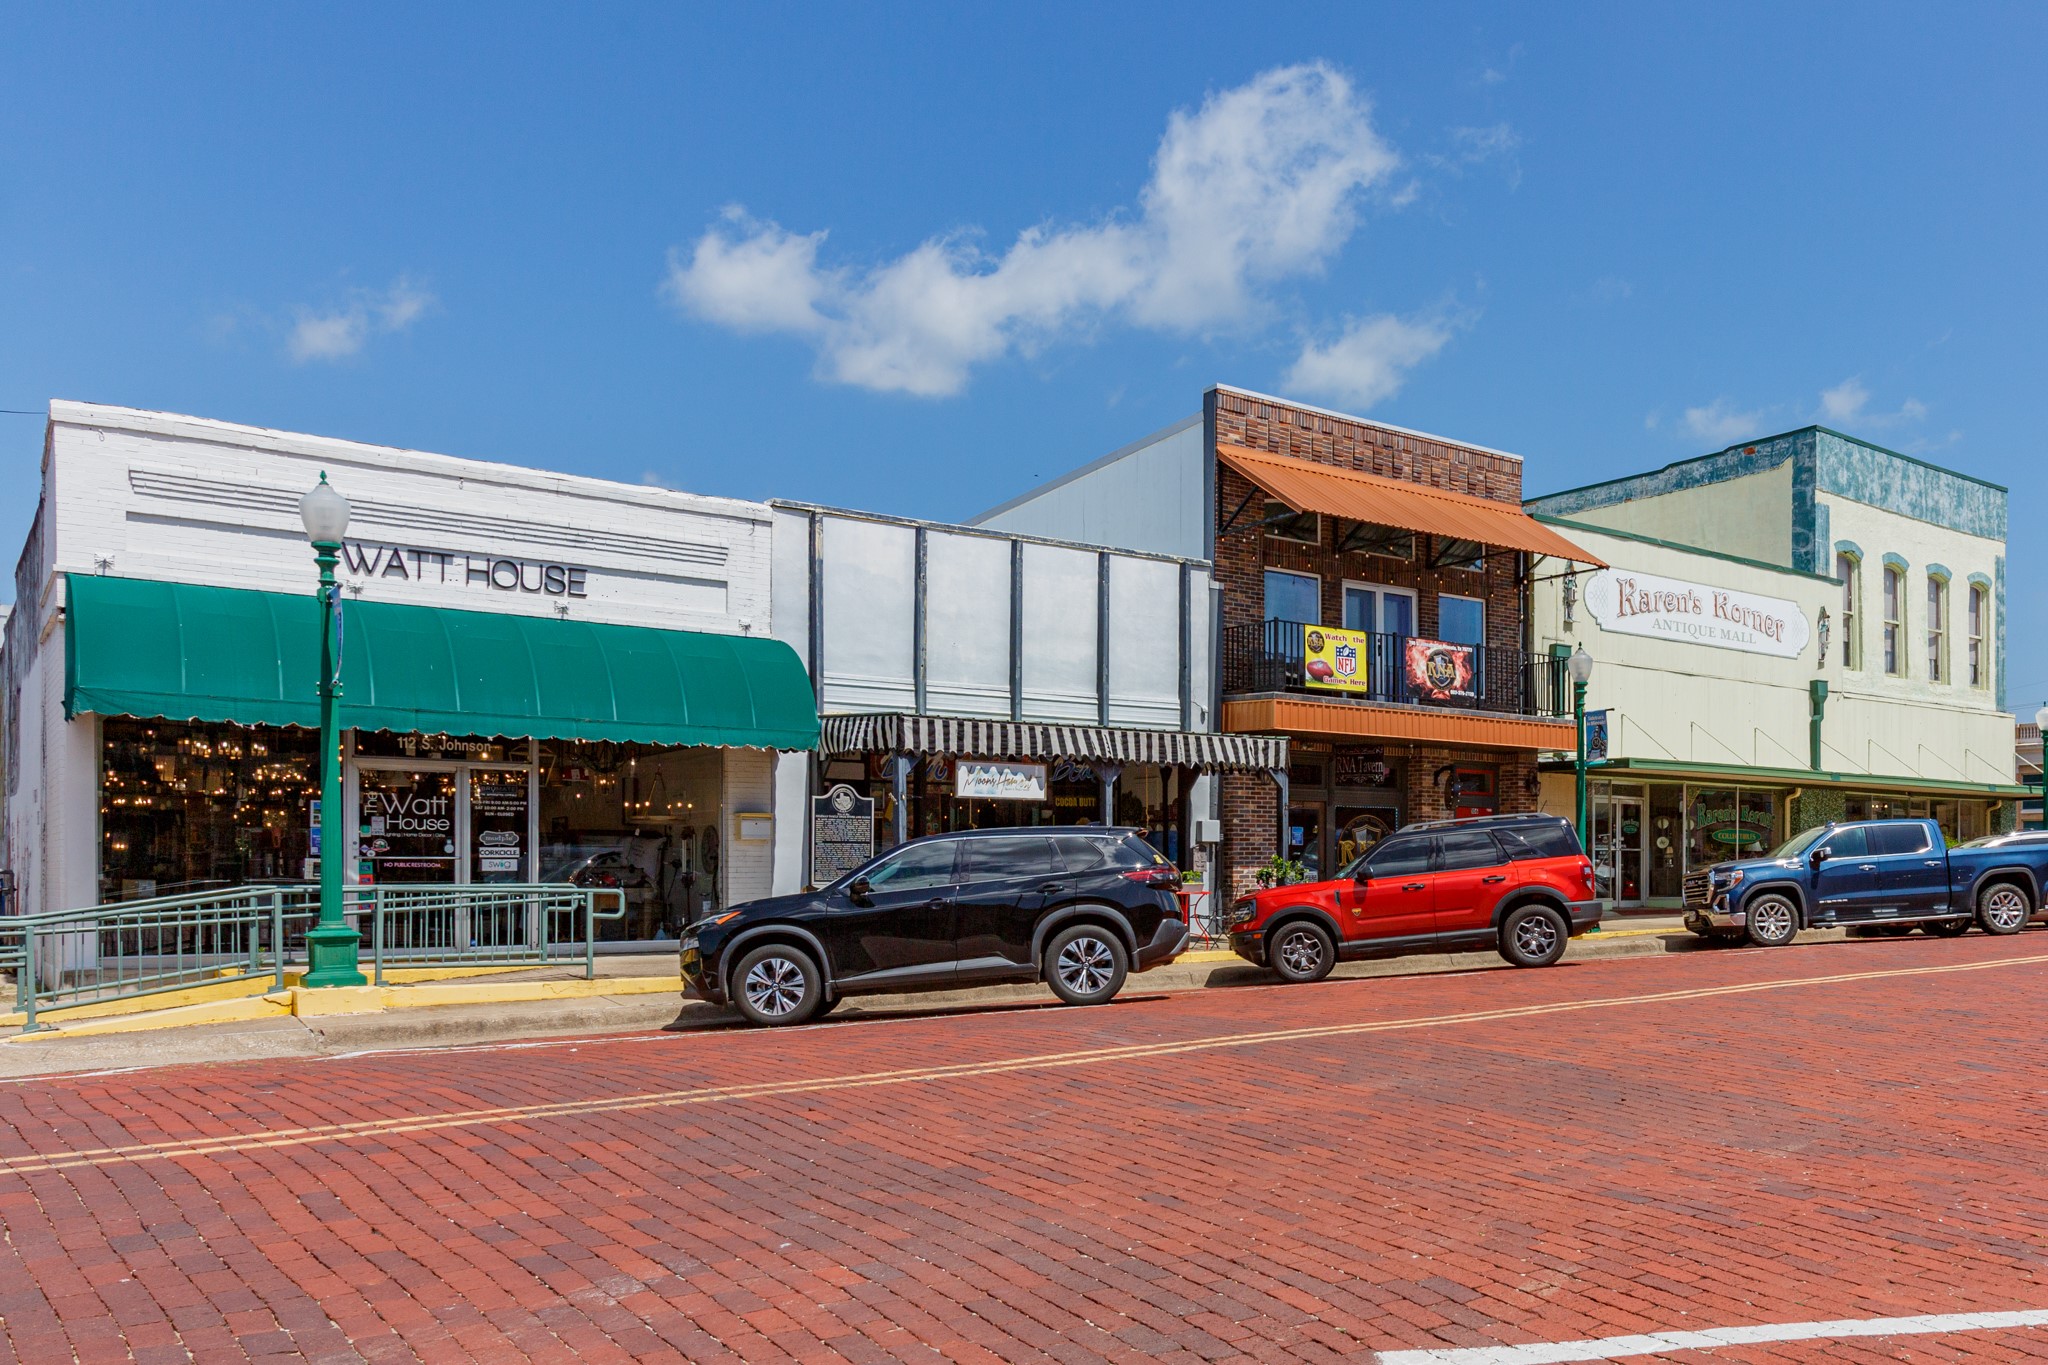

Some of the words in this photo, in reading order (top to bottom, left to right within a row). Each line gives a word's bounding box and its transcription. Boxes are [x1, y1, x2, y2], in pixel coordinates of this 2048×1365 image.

[342, 542, 455, 584] WATT
[466, 555, 588, 597] HOUSE
[1616, 577, 1703, 619] Karen's
[1713, 591, 1785, 643] Korner
[1324, 633, 1347, 642] Watch
[1352, 636, 1365, 644] the
[1652, 618, 1717, 640] ANTIQUE
[1720, 629, 1757, 645] MALL
[1337, 657, 1355, 673] NFL
[1427, 661, 1456, 678] RNA
[1323, 676, 1347, 685] Games
[1350, 678, 1366, 687] Here
[397, 736, 416, 750] 112
[422, 738, 434, 750] S.
[439, 738, 492, 753] Johnson
[1336, 756, 1356, 773] RNA
[1357, 756, 1384, 773] Tavern
[364, 791, 378, 816] The
[379, 792, 448, 815] Watt
[1055, 797, 1078, 807] COCOA
[386, 814, 450, 831] House
[1696, 803, 1737, 830] Karen's
